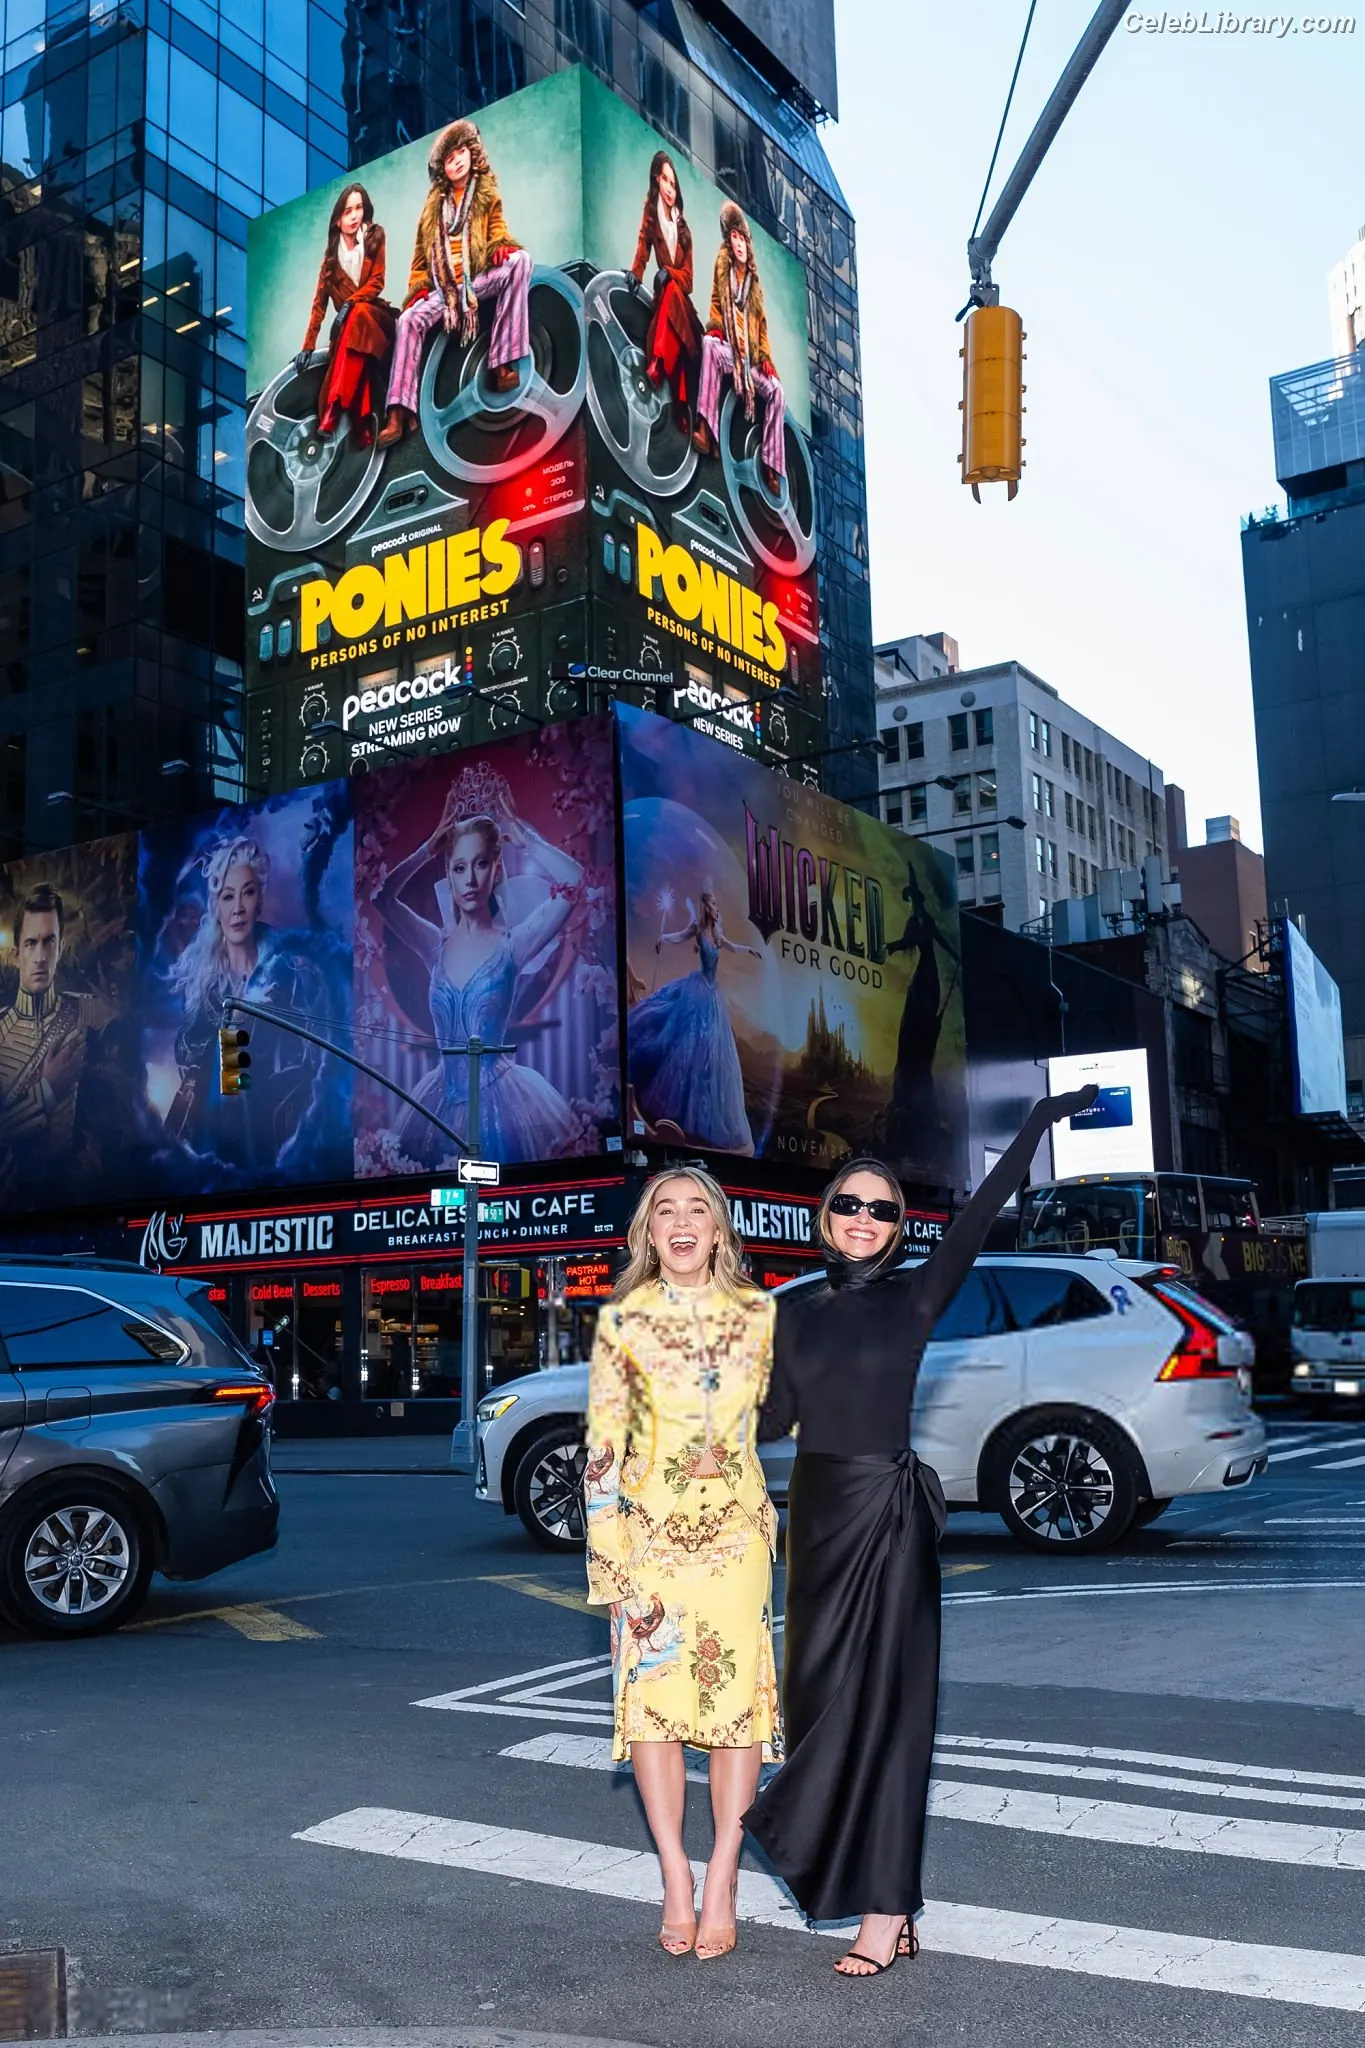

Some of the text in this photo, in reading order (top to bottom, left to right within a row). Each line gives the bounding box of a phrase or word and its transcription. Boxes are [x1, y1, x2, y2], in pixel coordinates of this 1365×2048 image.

[371, 524, 442, 558] peacock ORIGINAL
[690, 539, 716, 561] peacock
[300, 518, 521, 653] PONIES
[637, 522, 787, 671] PONIES
[310, 599, 510, 670] PERSONS OF NO INTEREST
[647, 607, 699, 646] PERSONS
[701, 638, 715, 654] OF
[717, 646, 731, 663] NO
[733, 655, 781, 689] INTEREST
[587, 666, 673, 683] Clear Channel
[343, 658, 461, 731] peacock
[673, 680, 755, 732] peacock
[369, 705, 442, 736] NEW SERIES
[694, 717, 744, 750] NEW SERIES
[351, 717, 461, 757] STREAMING NOW
[742, 800, 886, 965] WICKED
[781, 938, 883, 989] FOR GOOD
[777, 1136, 853, 1160] NOVEMBER
[354, 1194, 595, 1231] DELICATESN CAFE
[201, 1215, 333, 1259] MAJESTIC
[388, 1223, 568, 1246] BREAKFAST UNCH DINNER
[913, 1222, 943, 1240] CAFE
[908, 1245, 931, 1254] DINNER
[1166, 1239, 1180, 1256] BIG
[421, 1273, 463, 1291] Breakfast
[566, 1264, 609, 1276] PASTRAMI
[579, 1275, 597, 1285] HOT
[207, 1286, 226, 1300] stas
[252, 1285, 271, 1300] Cold
[303, 1282, 340, 1296] Desserts
[371, 1278, 410, 1296] Espresso
